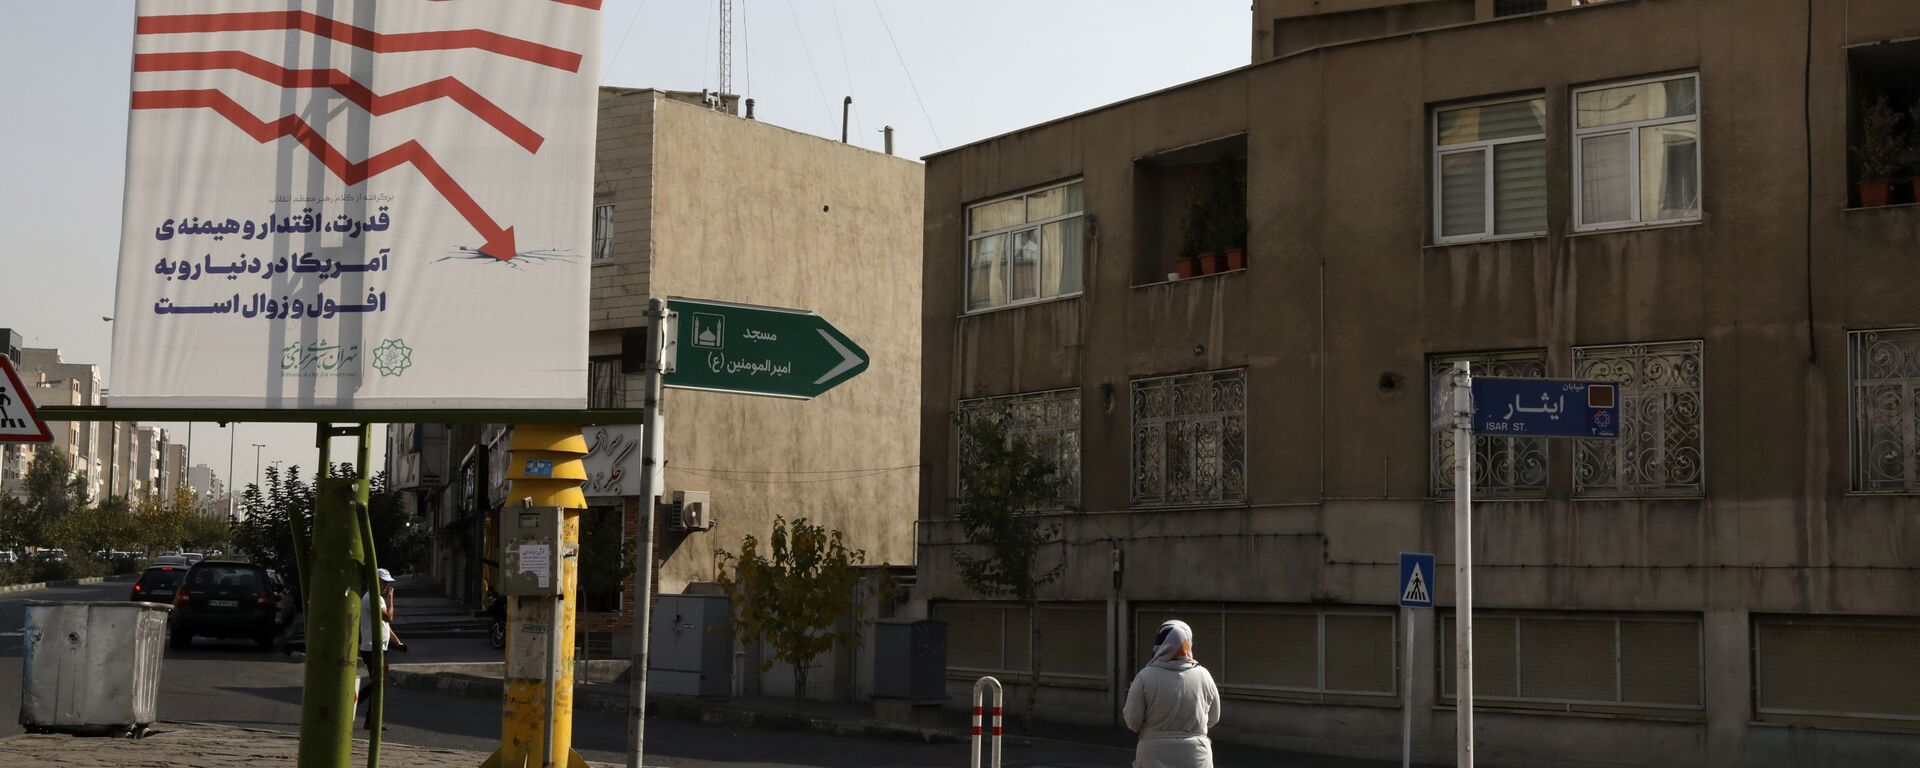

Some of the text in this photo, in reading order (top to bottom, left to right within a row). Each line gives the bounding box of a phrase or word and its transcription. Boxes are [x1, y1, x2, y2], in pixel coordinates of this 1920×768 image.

[242, 219, 256, 240] و
[256, 207, 322, 239] اقتدار
[204, 253, 262, 280] دنیا
[262, 256, 288, 280] در
[292, 248, 390, 279] آمریکا
[154, 286, 387, 319] افول و زوال است
[743, 328, 777, 343] مسجد
[707, 351, 725, 373] (ع)
[1562, 383, 1585, 391] خیابان
[1503, 392, 1564, 420] ایثار
[1486, 422, 1528, 432] ISAR ST.
